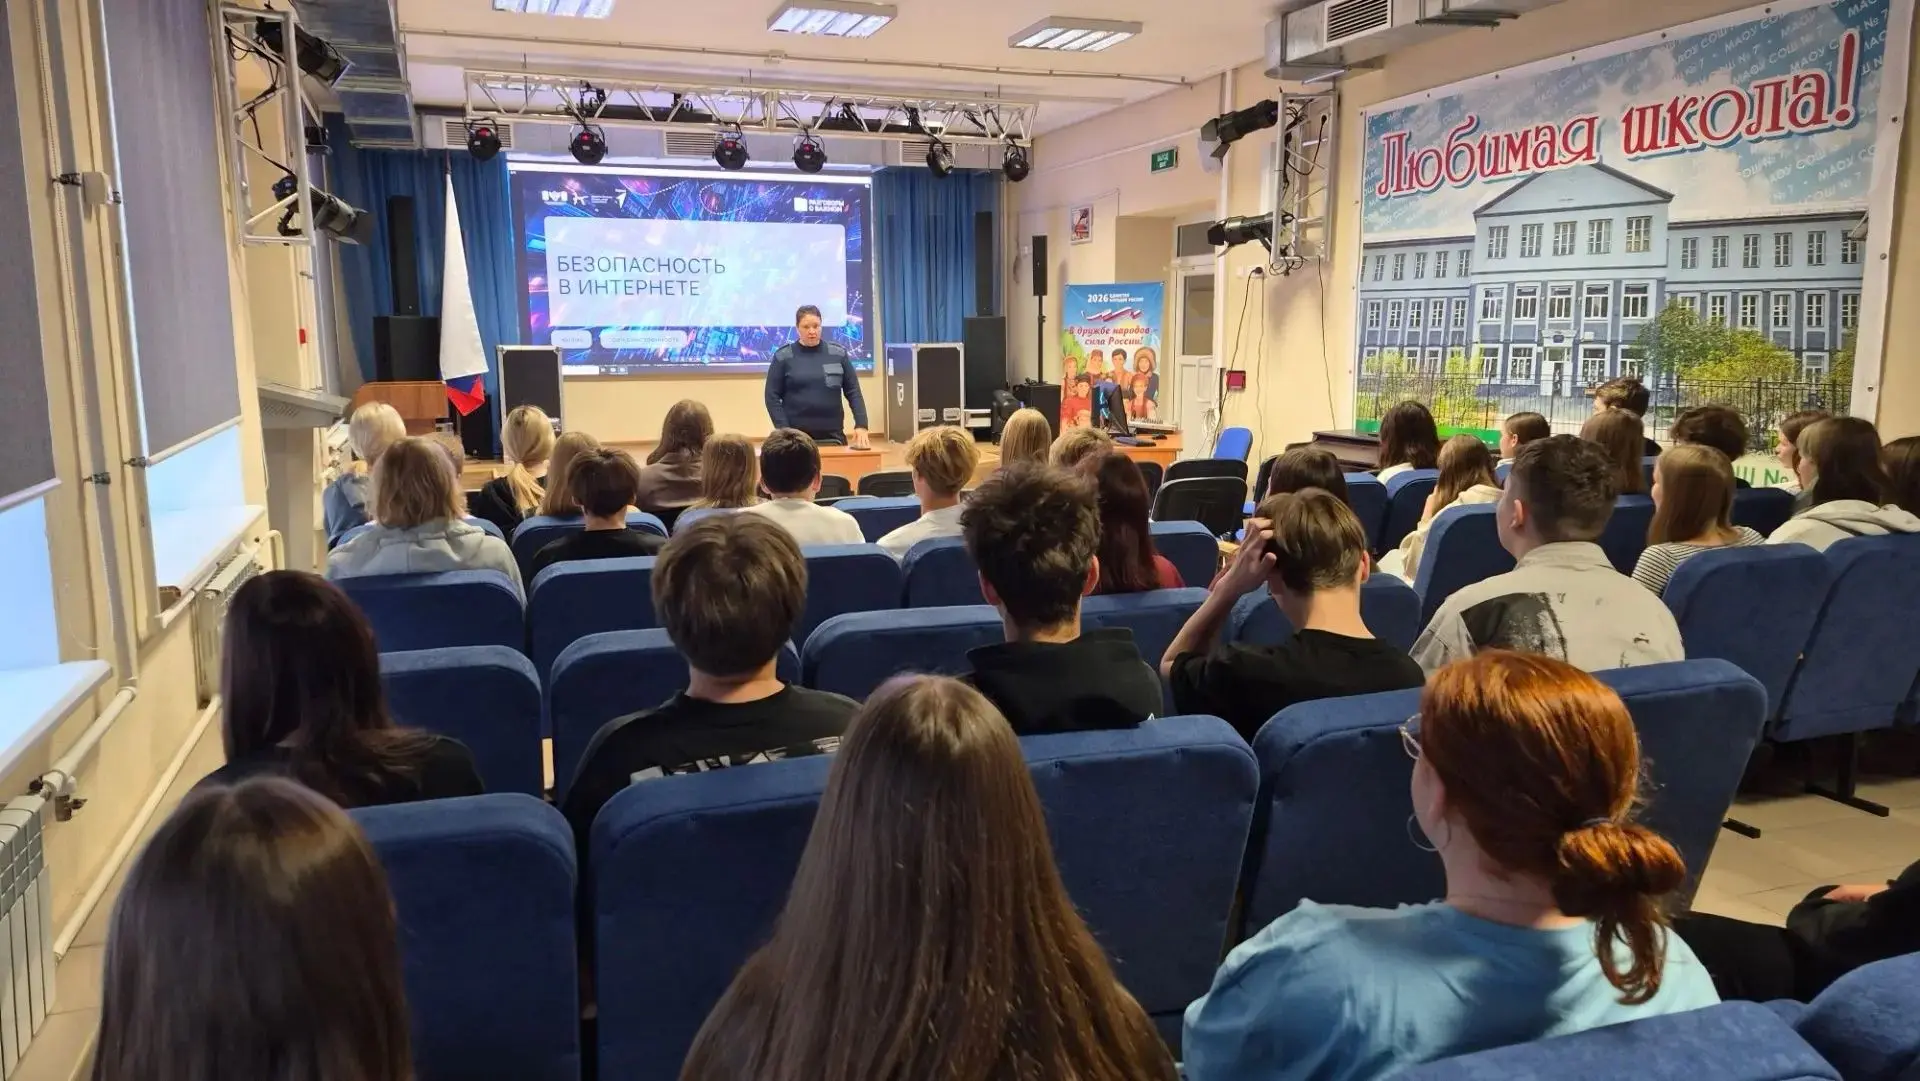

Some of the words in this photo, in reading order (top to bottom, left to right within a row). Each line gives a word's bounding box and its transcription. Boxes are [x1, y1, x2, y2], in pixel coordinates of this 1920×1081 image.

[1375, 114, 1600, 197] Любимая
[1622, 34, 1858, 154] школа!
[557, 255, 726, 274] БЕЗОПАСНОСТЬ
[559, 279, 571, 295] В
[579, 279, 701, 296] ИНТЕРНЕТЕ
[1087, 293, 1109, 303] 2026
[1077, 326, 1111, 337] дружбе
[1113, 325, 1150, 337] народов
[1108, 336, 1144, 345] России!
